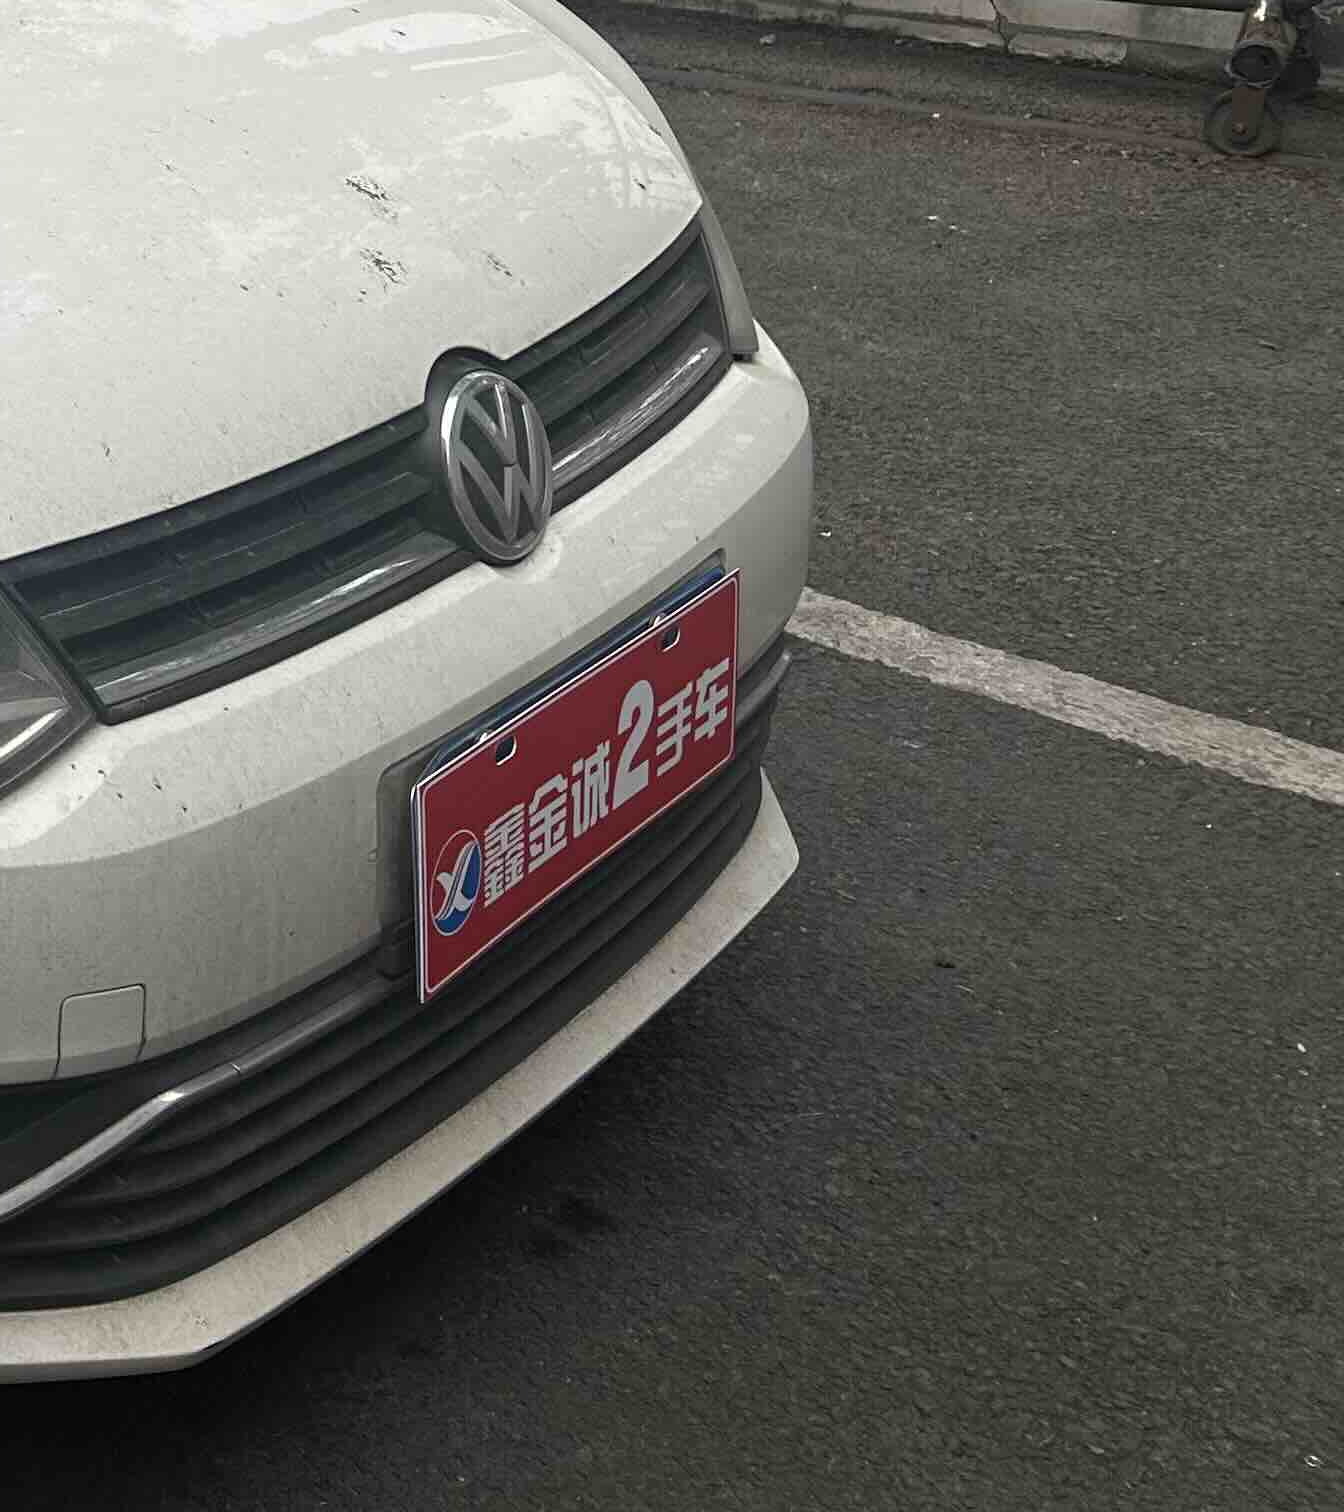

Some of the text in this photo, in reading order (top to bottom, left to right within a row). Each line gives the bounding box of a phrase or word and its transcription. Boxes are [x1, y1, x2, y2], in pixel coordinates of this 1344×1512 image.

[484, 657, 729, 908] 鑫金诚2手车
